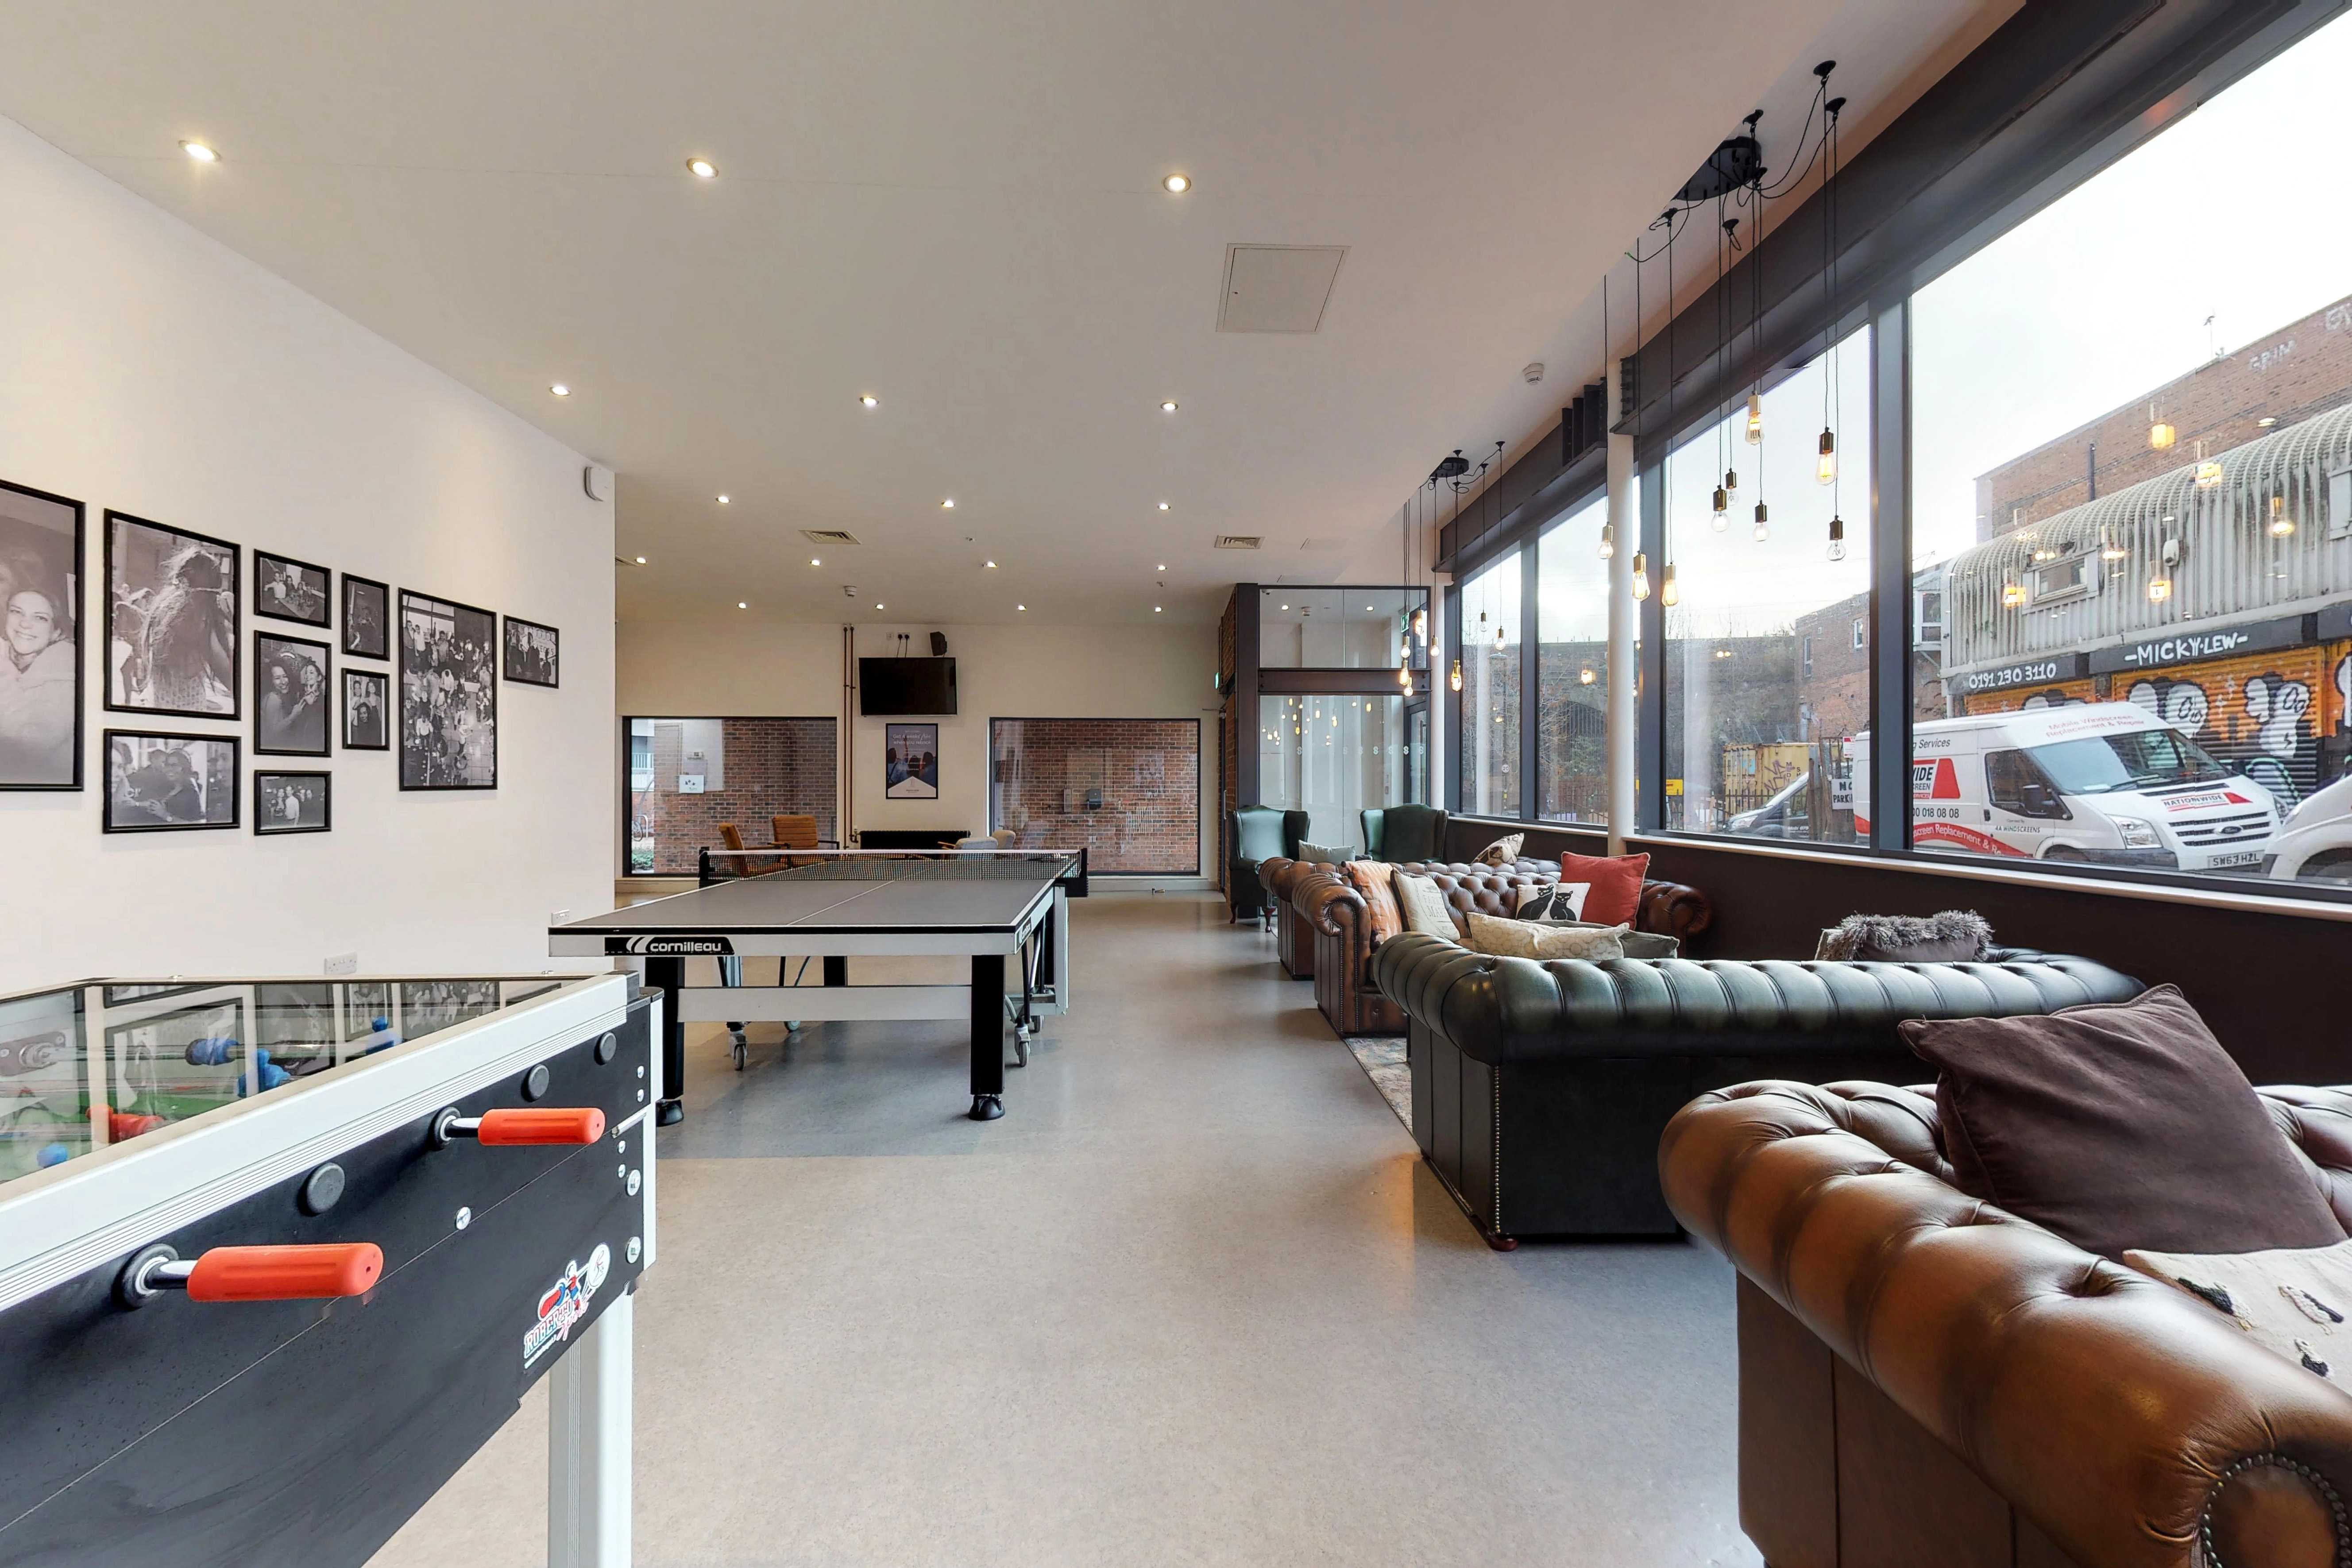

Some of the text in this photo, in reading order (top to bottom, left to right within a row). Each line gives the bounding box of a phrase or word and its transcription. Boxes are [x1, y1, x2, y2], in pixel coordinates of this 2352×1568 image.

[1969, 663, 2056, 689] 0191 230 3110
[1919, 738, 1950, 749] Services
[1922, 807, 1934, 818] 018
[1937, 808, 1946, 818] 08
[1949, 808, 1959, 818] 08
[1935, 823, 1981, 846] Replacement
[1982, 839, 1989, 850] &
[2241, 853, 2260, 863] HZL
[650, 942, 721, 952] cornilleau
[525, 1297, 574, 1356] ROBERTO
